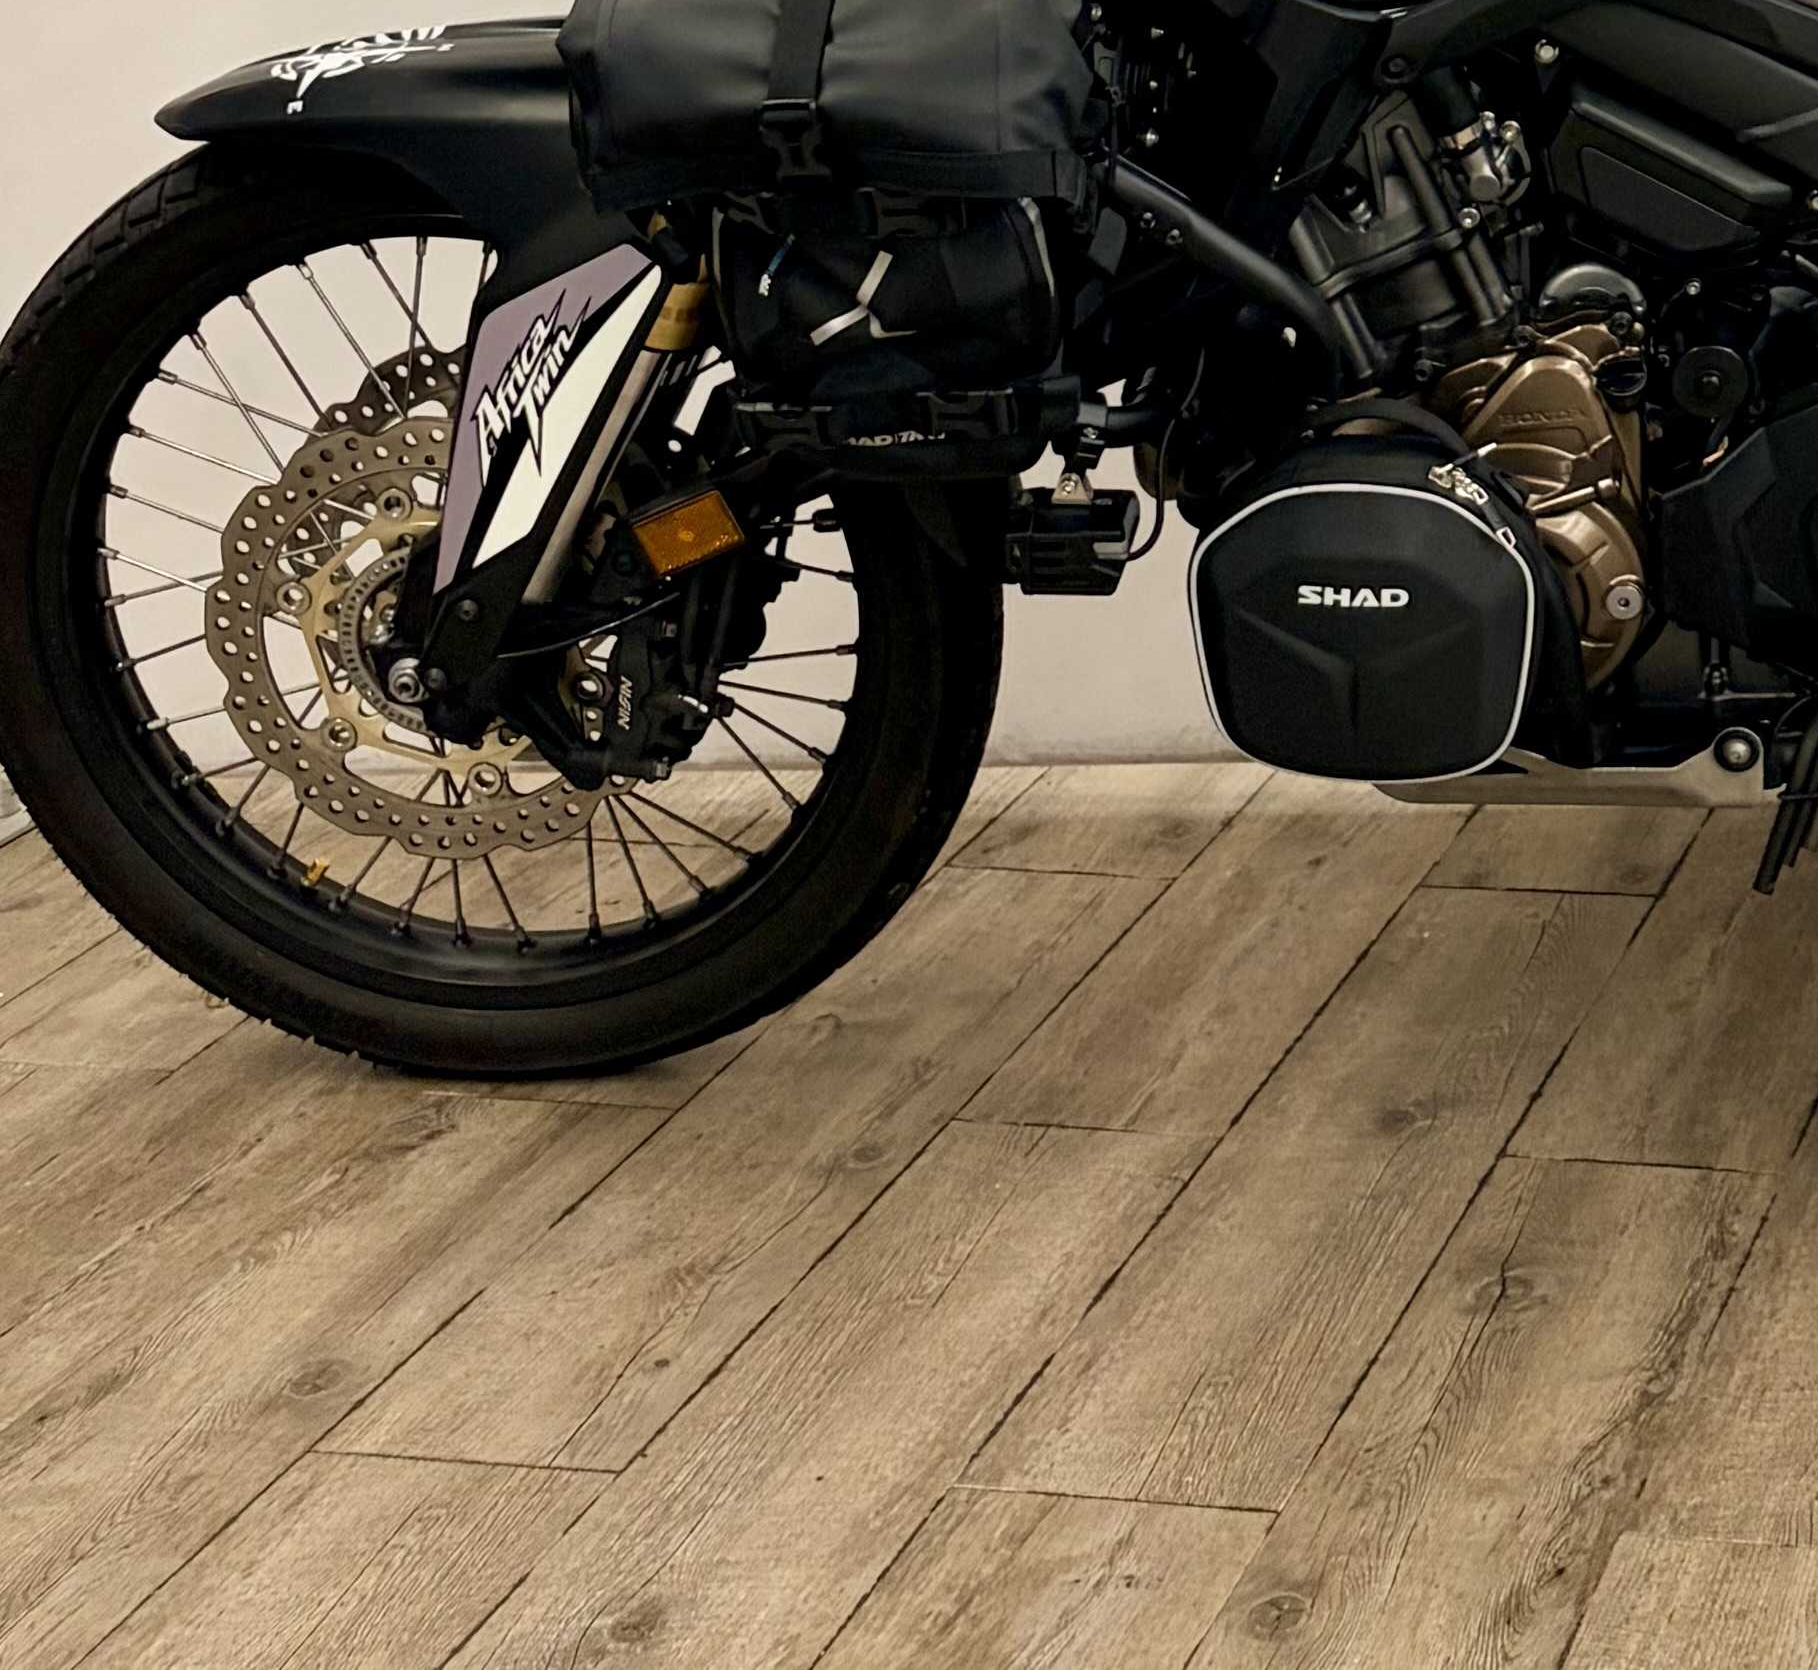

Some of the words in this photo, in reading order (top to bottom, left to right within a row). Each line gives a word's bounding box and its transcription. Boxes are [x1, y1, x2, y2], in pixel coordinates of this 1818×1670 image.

[470, 287, 567, 492] Africa
[511, 295, 592, 478] Twin
[1297, 584, 1410, 608] SHAD
